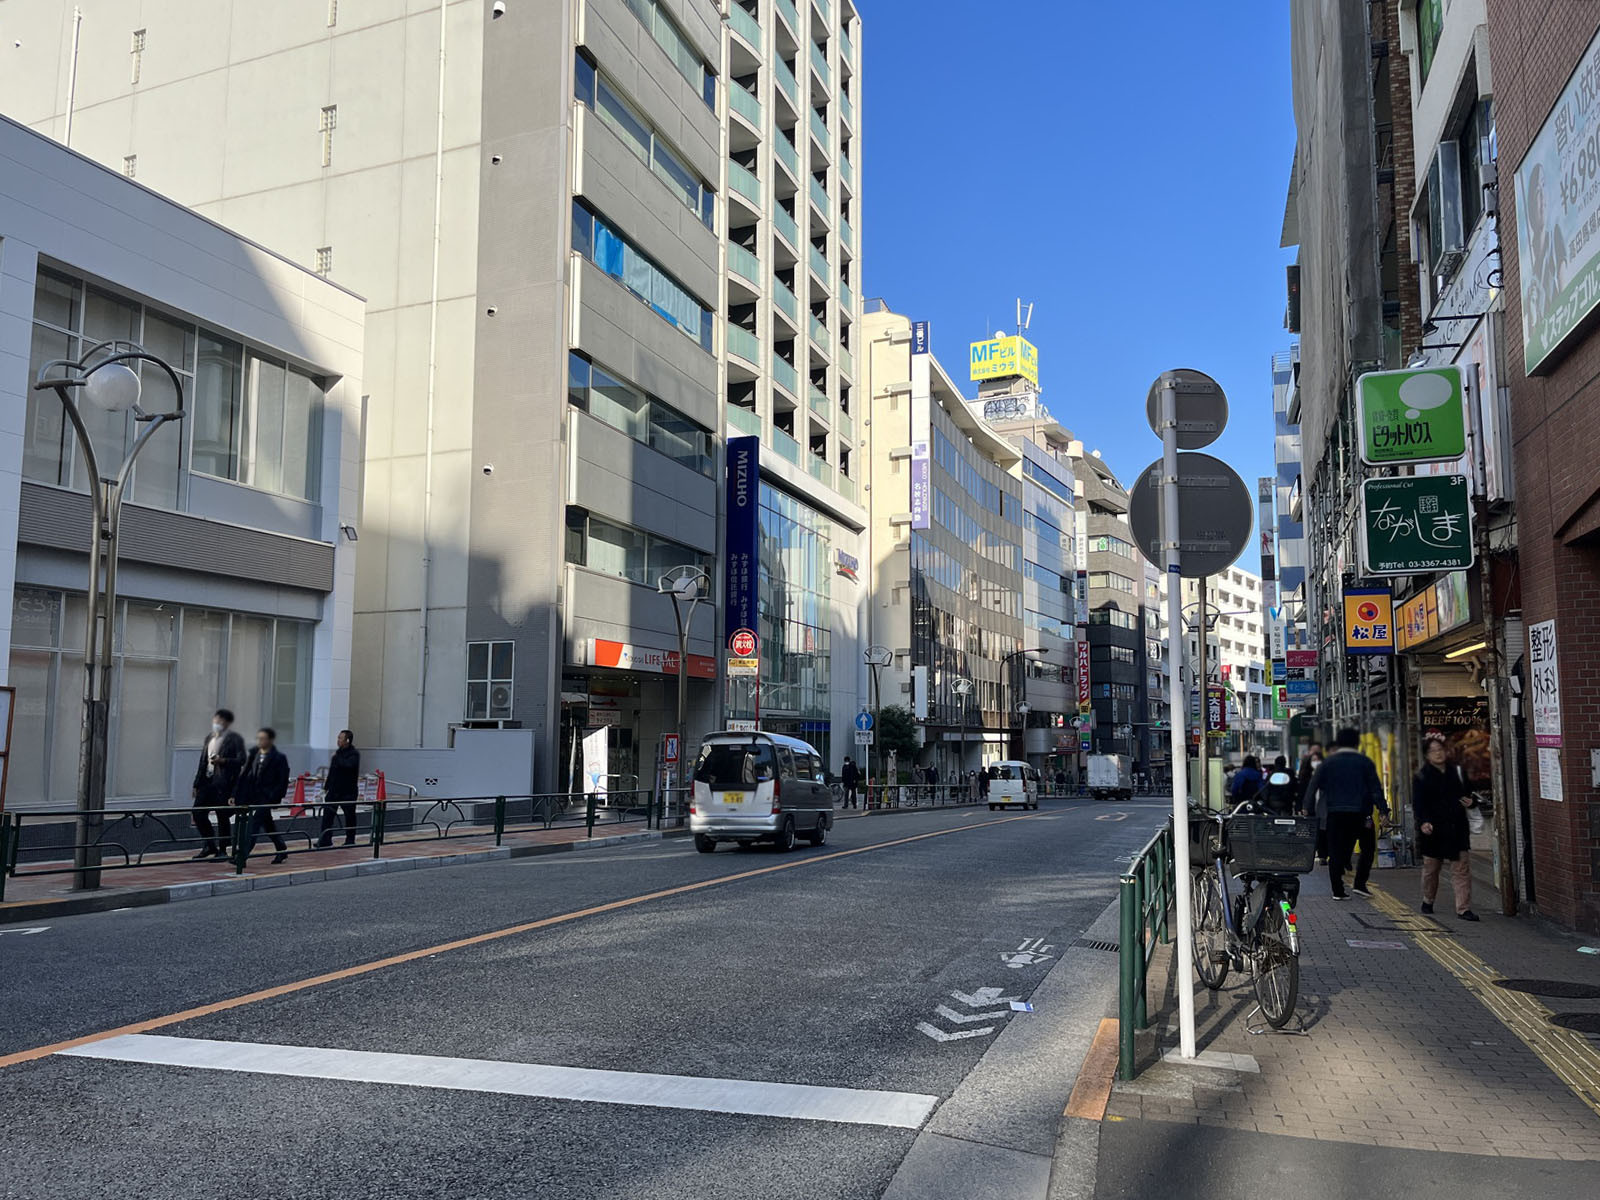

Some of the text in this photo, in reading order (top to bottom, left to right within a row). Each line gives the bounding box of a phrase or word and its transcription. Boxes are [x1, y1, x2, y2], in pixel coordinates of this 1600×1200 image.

[1568, 206, 1600, 262] 高田馬場
[1373, 421, 1432, 448] ピタットハウス
[736, 450, 749, 507] MIZUHO
[1450, 476, 1465, 486] 3F
[1370, 497, 1464, 548] ながしま
[1408, 559, 1461, 569] 03-3367-4381
[1352, 624, 1388, 640] 松屋
[1531, 623, 1555, 663] 整形
[1079, 643, 1088, 699] ツルハドラッグ
[1533, 666, 1557, 704] 外科
[1208, 697, 1221, 730] 大売出し
[1423, 715, 1451, 726] BEEF
